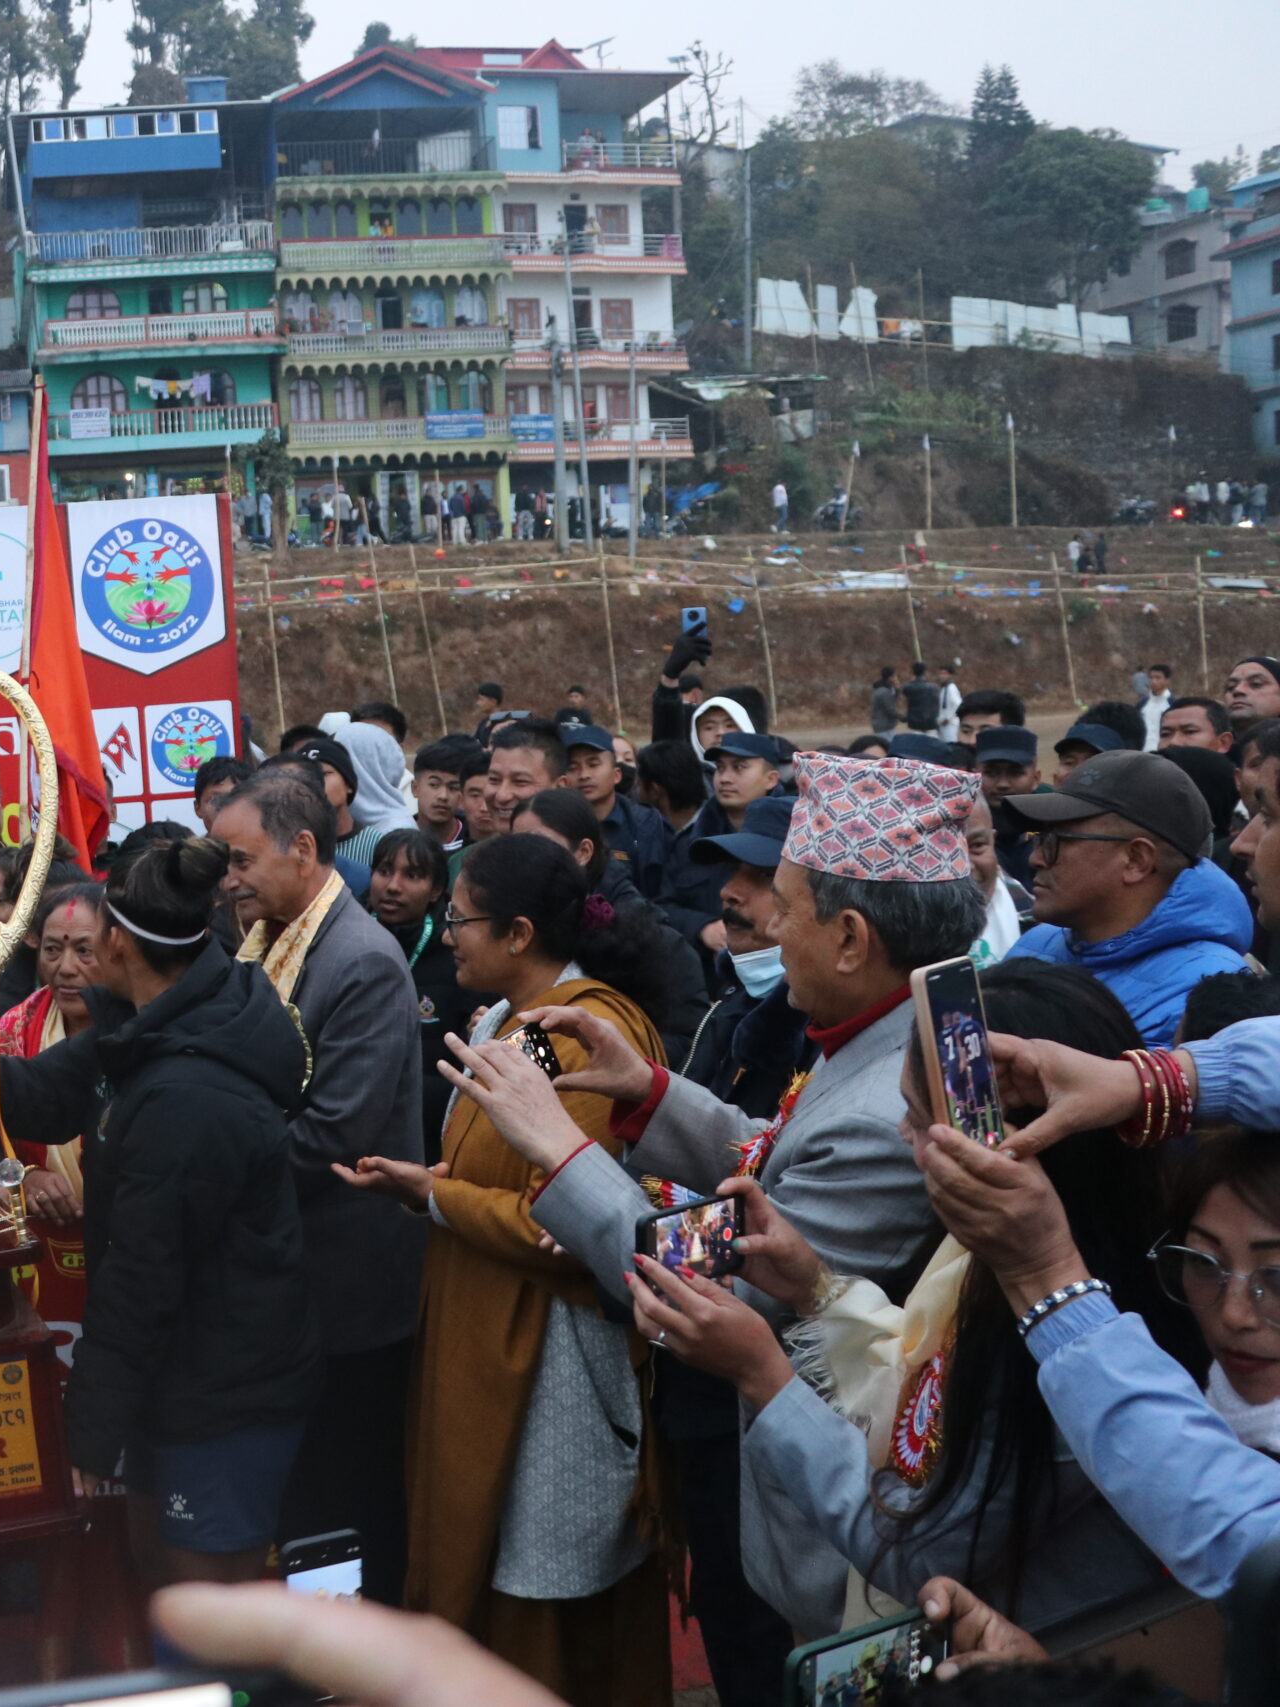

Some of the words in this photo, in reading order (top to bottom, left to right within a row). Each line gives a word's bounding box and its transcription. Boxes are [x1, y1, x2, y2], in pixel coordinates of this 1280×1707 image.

[86, 527, 134, 578] Club
[142, 520, 202, 568] Oasis
[158, 614, 199, 644] 2072
[153, 712, 183, 742] Club
[187, 708, 223, 736] Oasis
[166, 1509, 194, 1521] KELME
